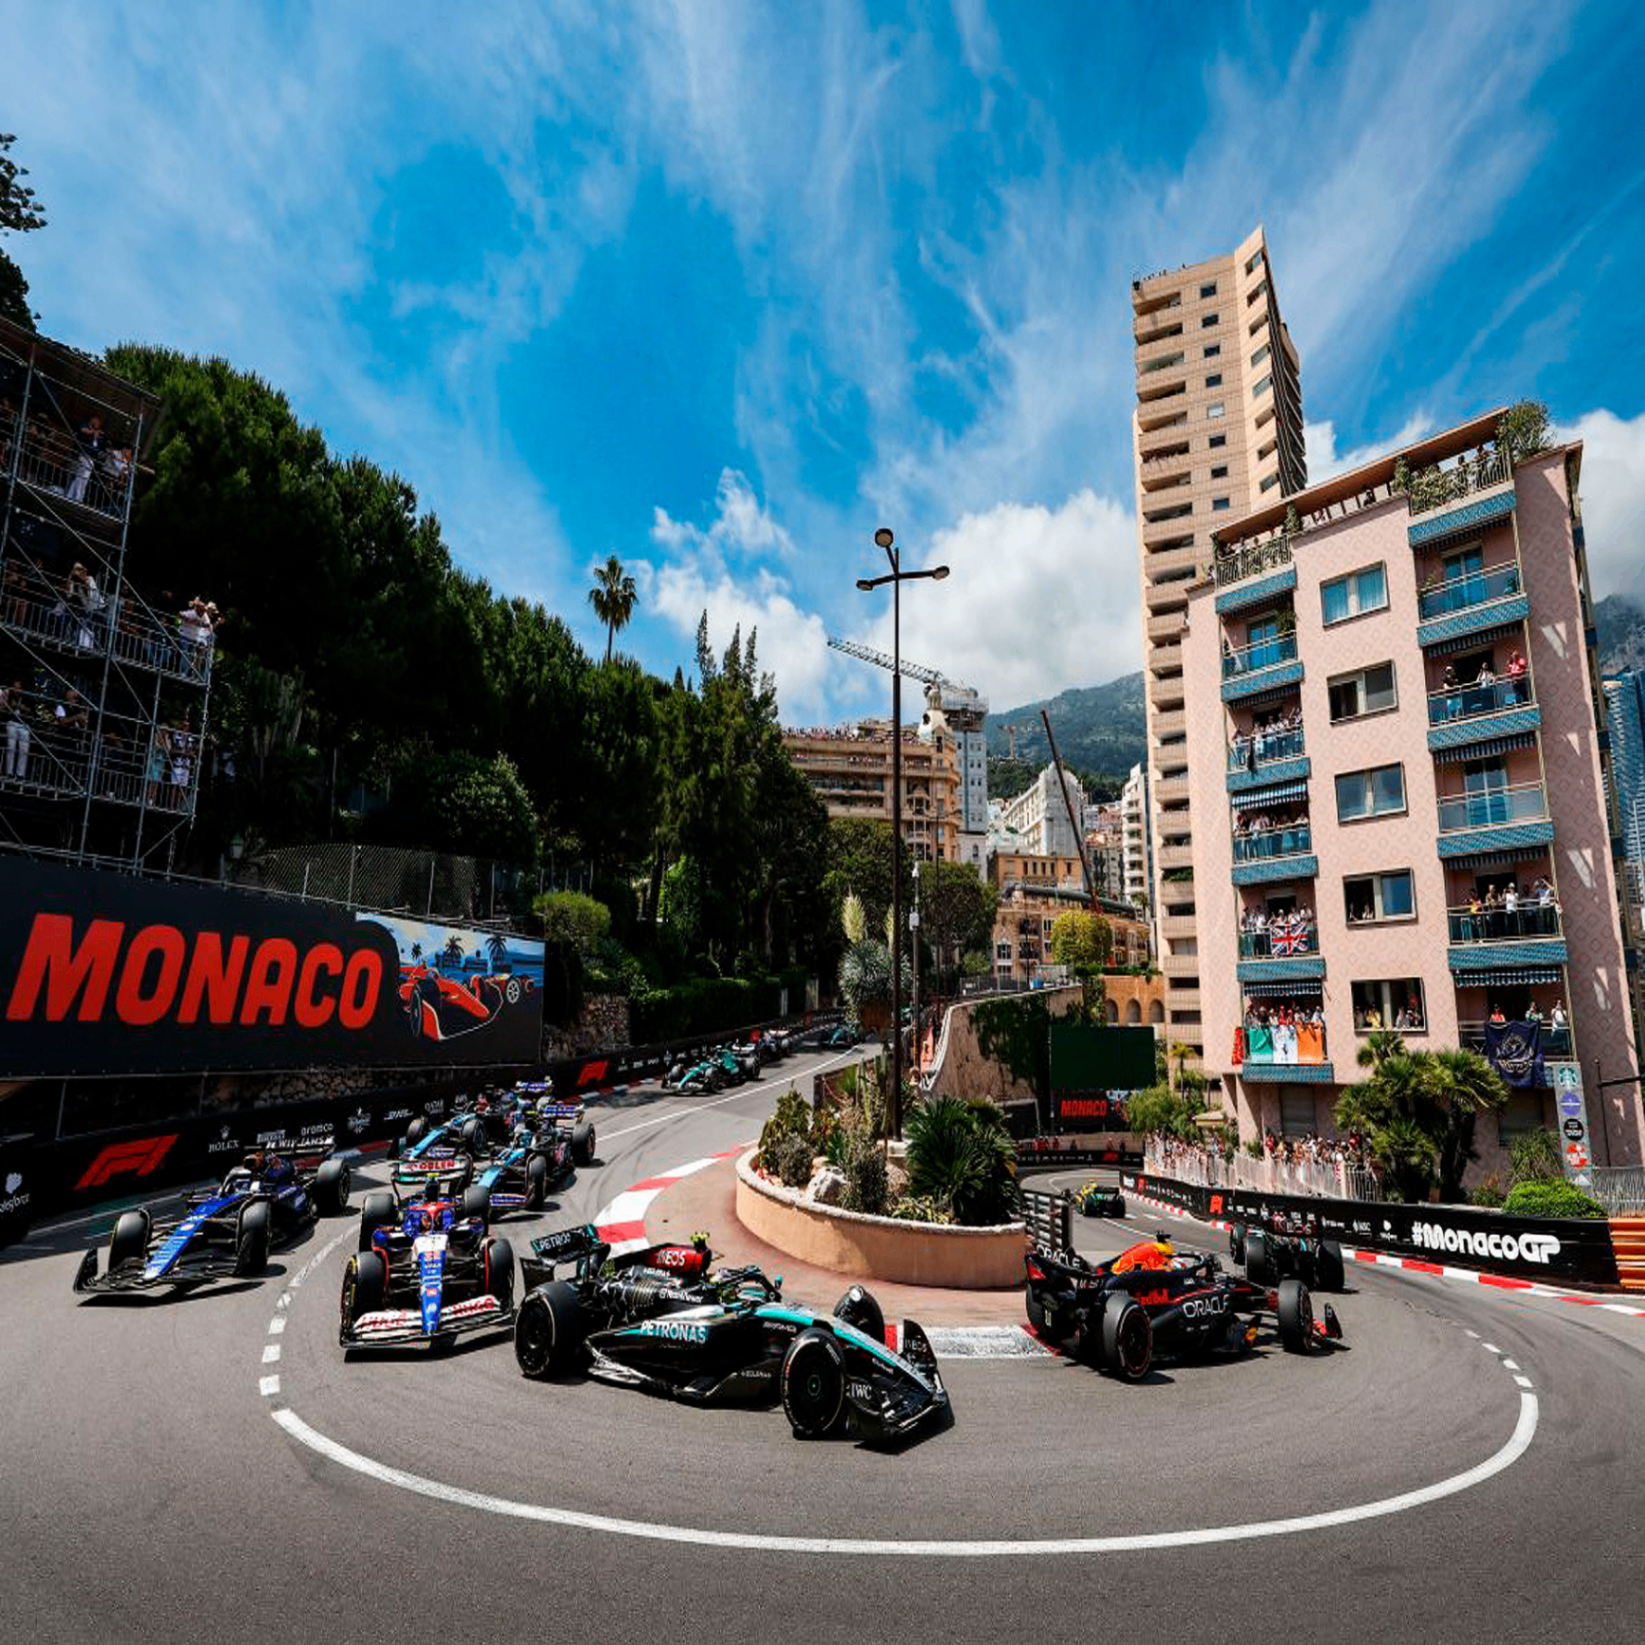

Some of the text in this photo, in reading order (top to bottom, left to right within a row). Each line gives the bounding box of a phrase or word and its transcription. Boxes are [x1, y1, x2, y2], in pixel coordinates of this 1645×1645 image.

[6, 913, 384, 1030] MONACO
[1061, 1099, 1108, 1117] MONACO
[208, 1140, 240, 1153] ROLEX
[1411, 1220, 1561, 1264] #MonacoGP
[1036, 1243, 1081, 1270] ORACLE
[640, 1319, 707, 1345] PETRONAS
[851, 1383, 873, 1400] IWC
